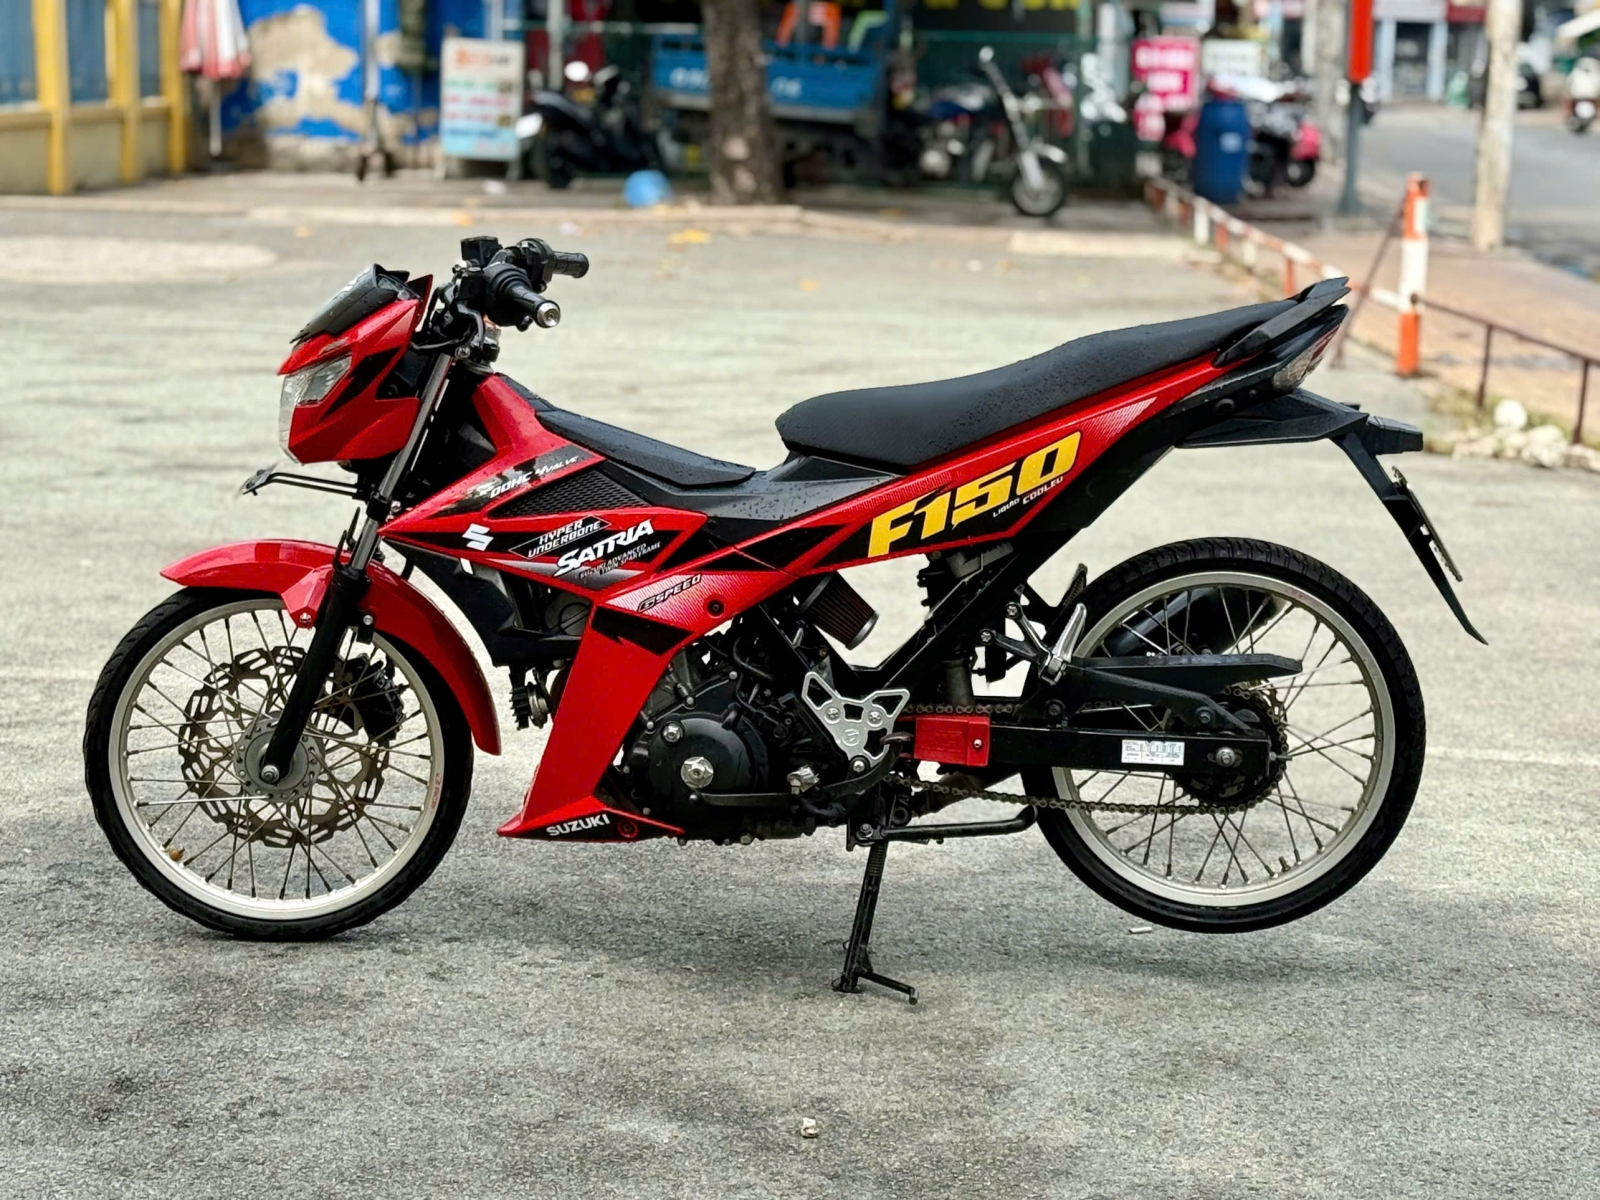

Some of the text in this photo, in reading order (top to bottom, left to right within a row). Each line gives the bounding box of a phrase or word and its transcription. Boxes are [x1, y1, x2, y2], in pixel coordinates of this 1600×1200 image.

[490, 471, 533, 499] DOHC
[867, 431, 1081, 558] F150
[538, 519, 584, 545] HYPER
[553, 518, 655, 577] SATRIA
[607, 542, 647, 567] ADVANCED
[546, 793, 611, 837] SUZUKI
